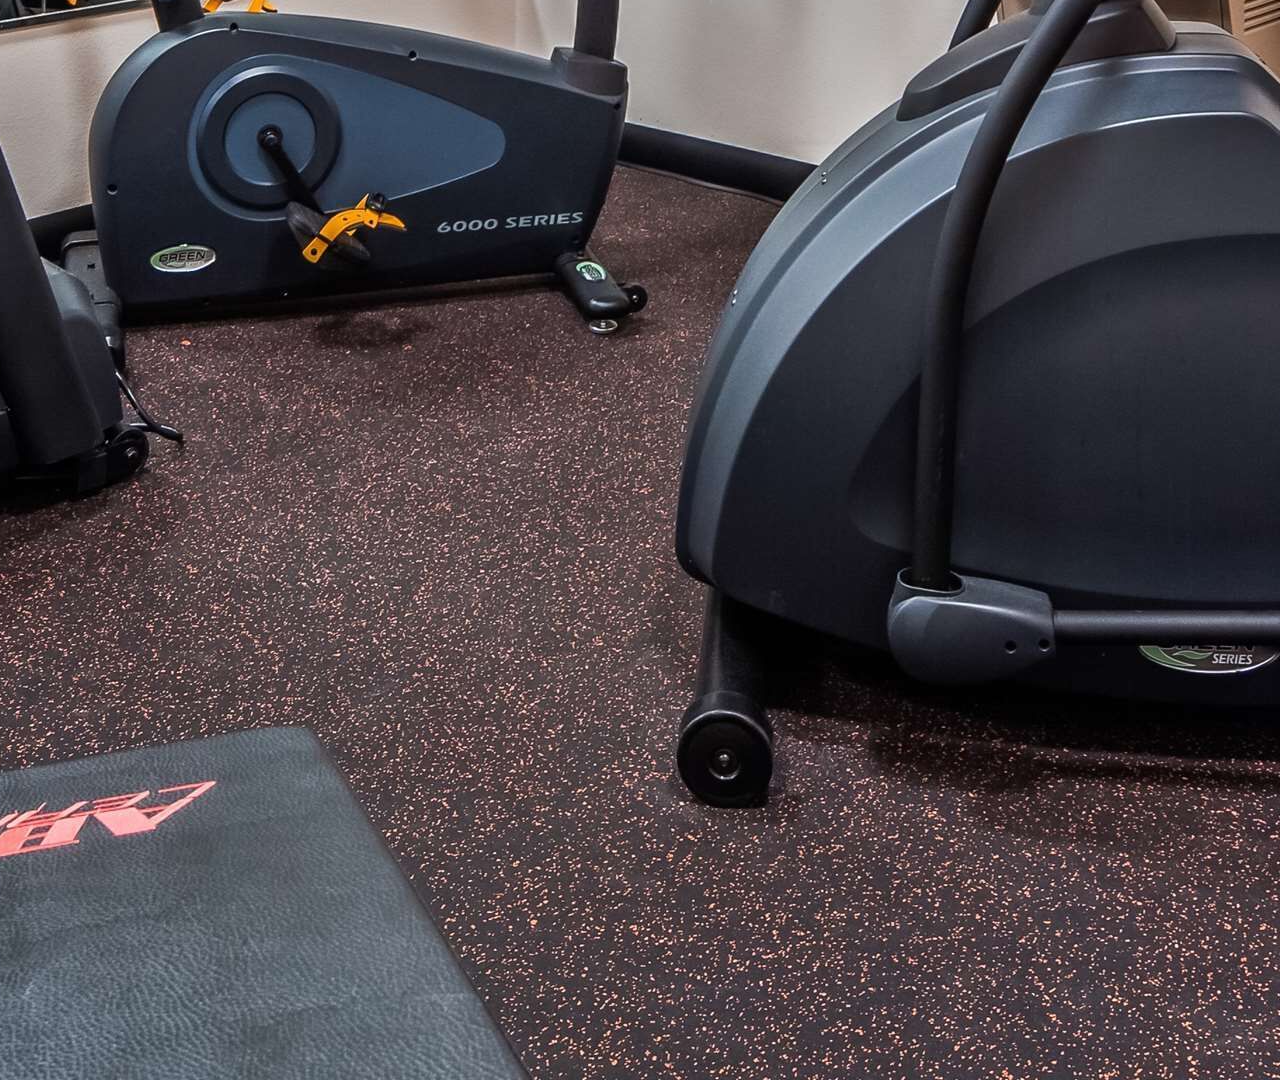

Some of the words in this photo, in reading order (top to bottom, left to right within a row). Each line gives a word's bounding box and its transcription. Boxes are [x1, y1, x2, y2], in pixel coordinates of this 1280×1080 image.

[437, 219, 499, 233] 6000
[504, 212, 584, 228] SERIES
[1212, 653, 1253, 664] SERIES
